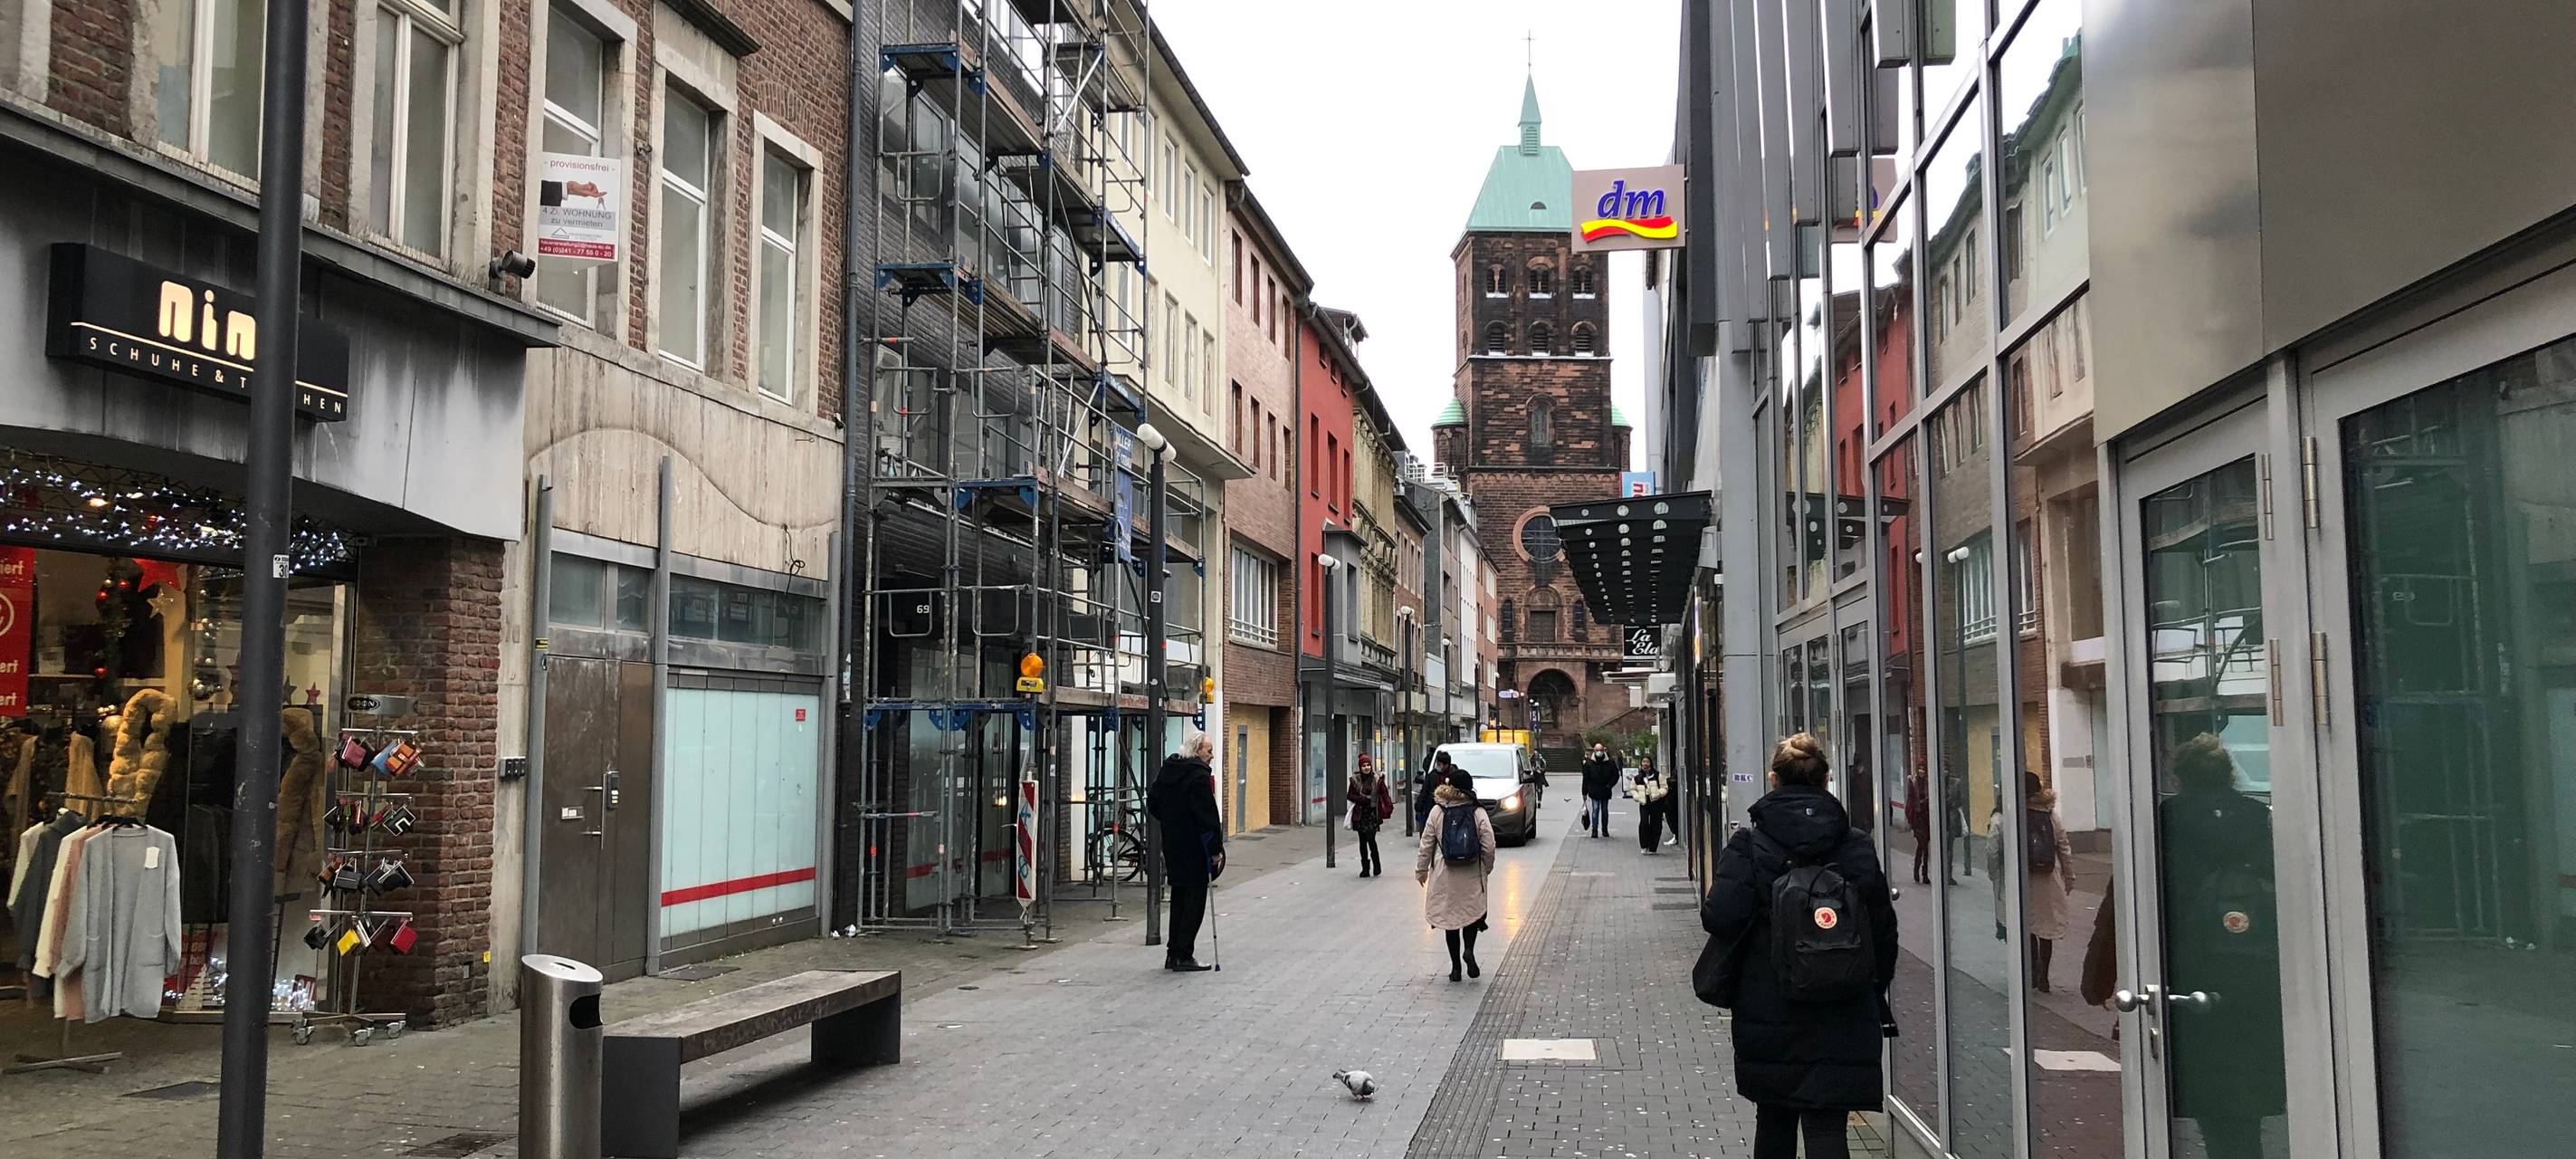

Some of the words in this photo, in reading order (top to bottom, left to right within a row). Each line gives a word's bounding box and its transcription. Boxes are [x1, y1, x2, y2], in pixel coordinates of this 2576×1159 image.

[550, 159, 609, 172] provisionsfrei
[1597, 179, 1665, 218] dm
[563, 208, 612, 220] WOHNUNG
[563, 218, 604, 227] vermieten
[158, 280, 256, 360] nin
[90, 337, 199, 377] SCHUHE
[215, 369, 224, 383] &
[240, 377, 341, 414] THEN
[916, 604, 930, 614] 69
[1625, 628, 1652, 645] La
